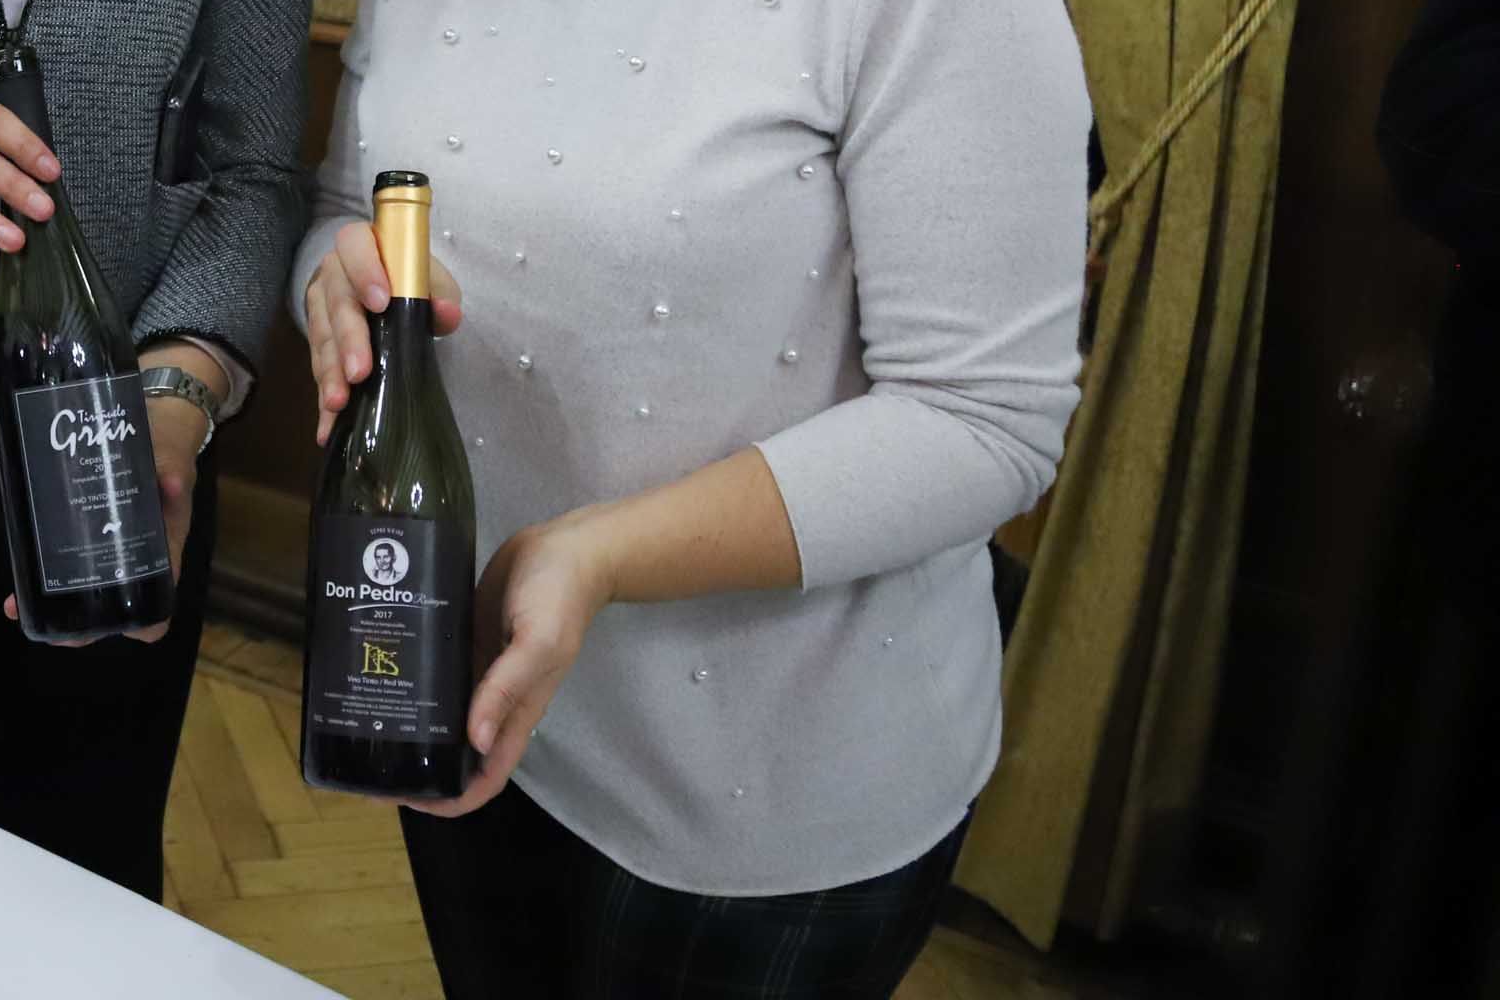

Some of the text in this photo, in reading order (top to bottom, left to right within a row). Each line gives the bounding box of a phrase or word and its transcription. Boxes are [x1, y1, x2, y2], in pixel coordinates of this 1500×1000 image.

[50, 408, 136, 457] Gran
[326, 581, 355, 599] Don
[359, 584, 413, 603] Pedro
[373, 610, 393, 619] 2017
